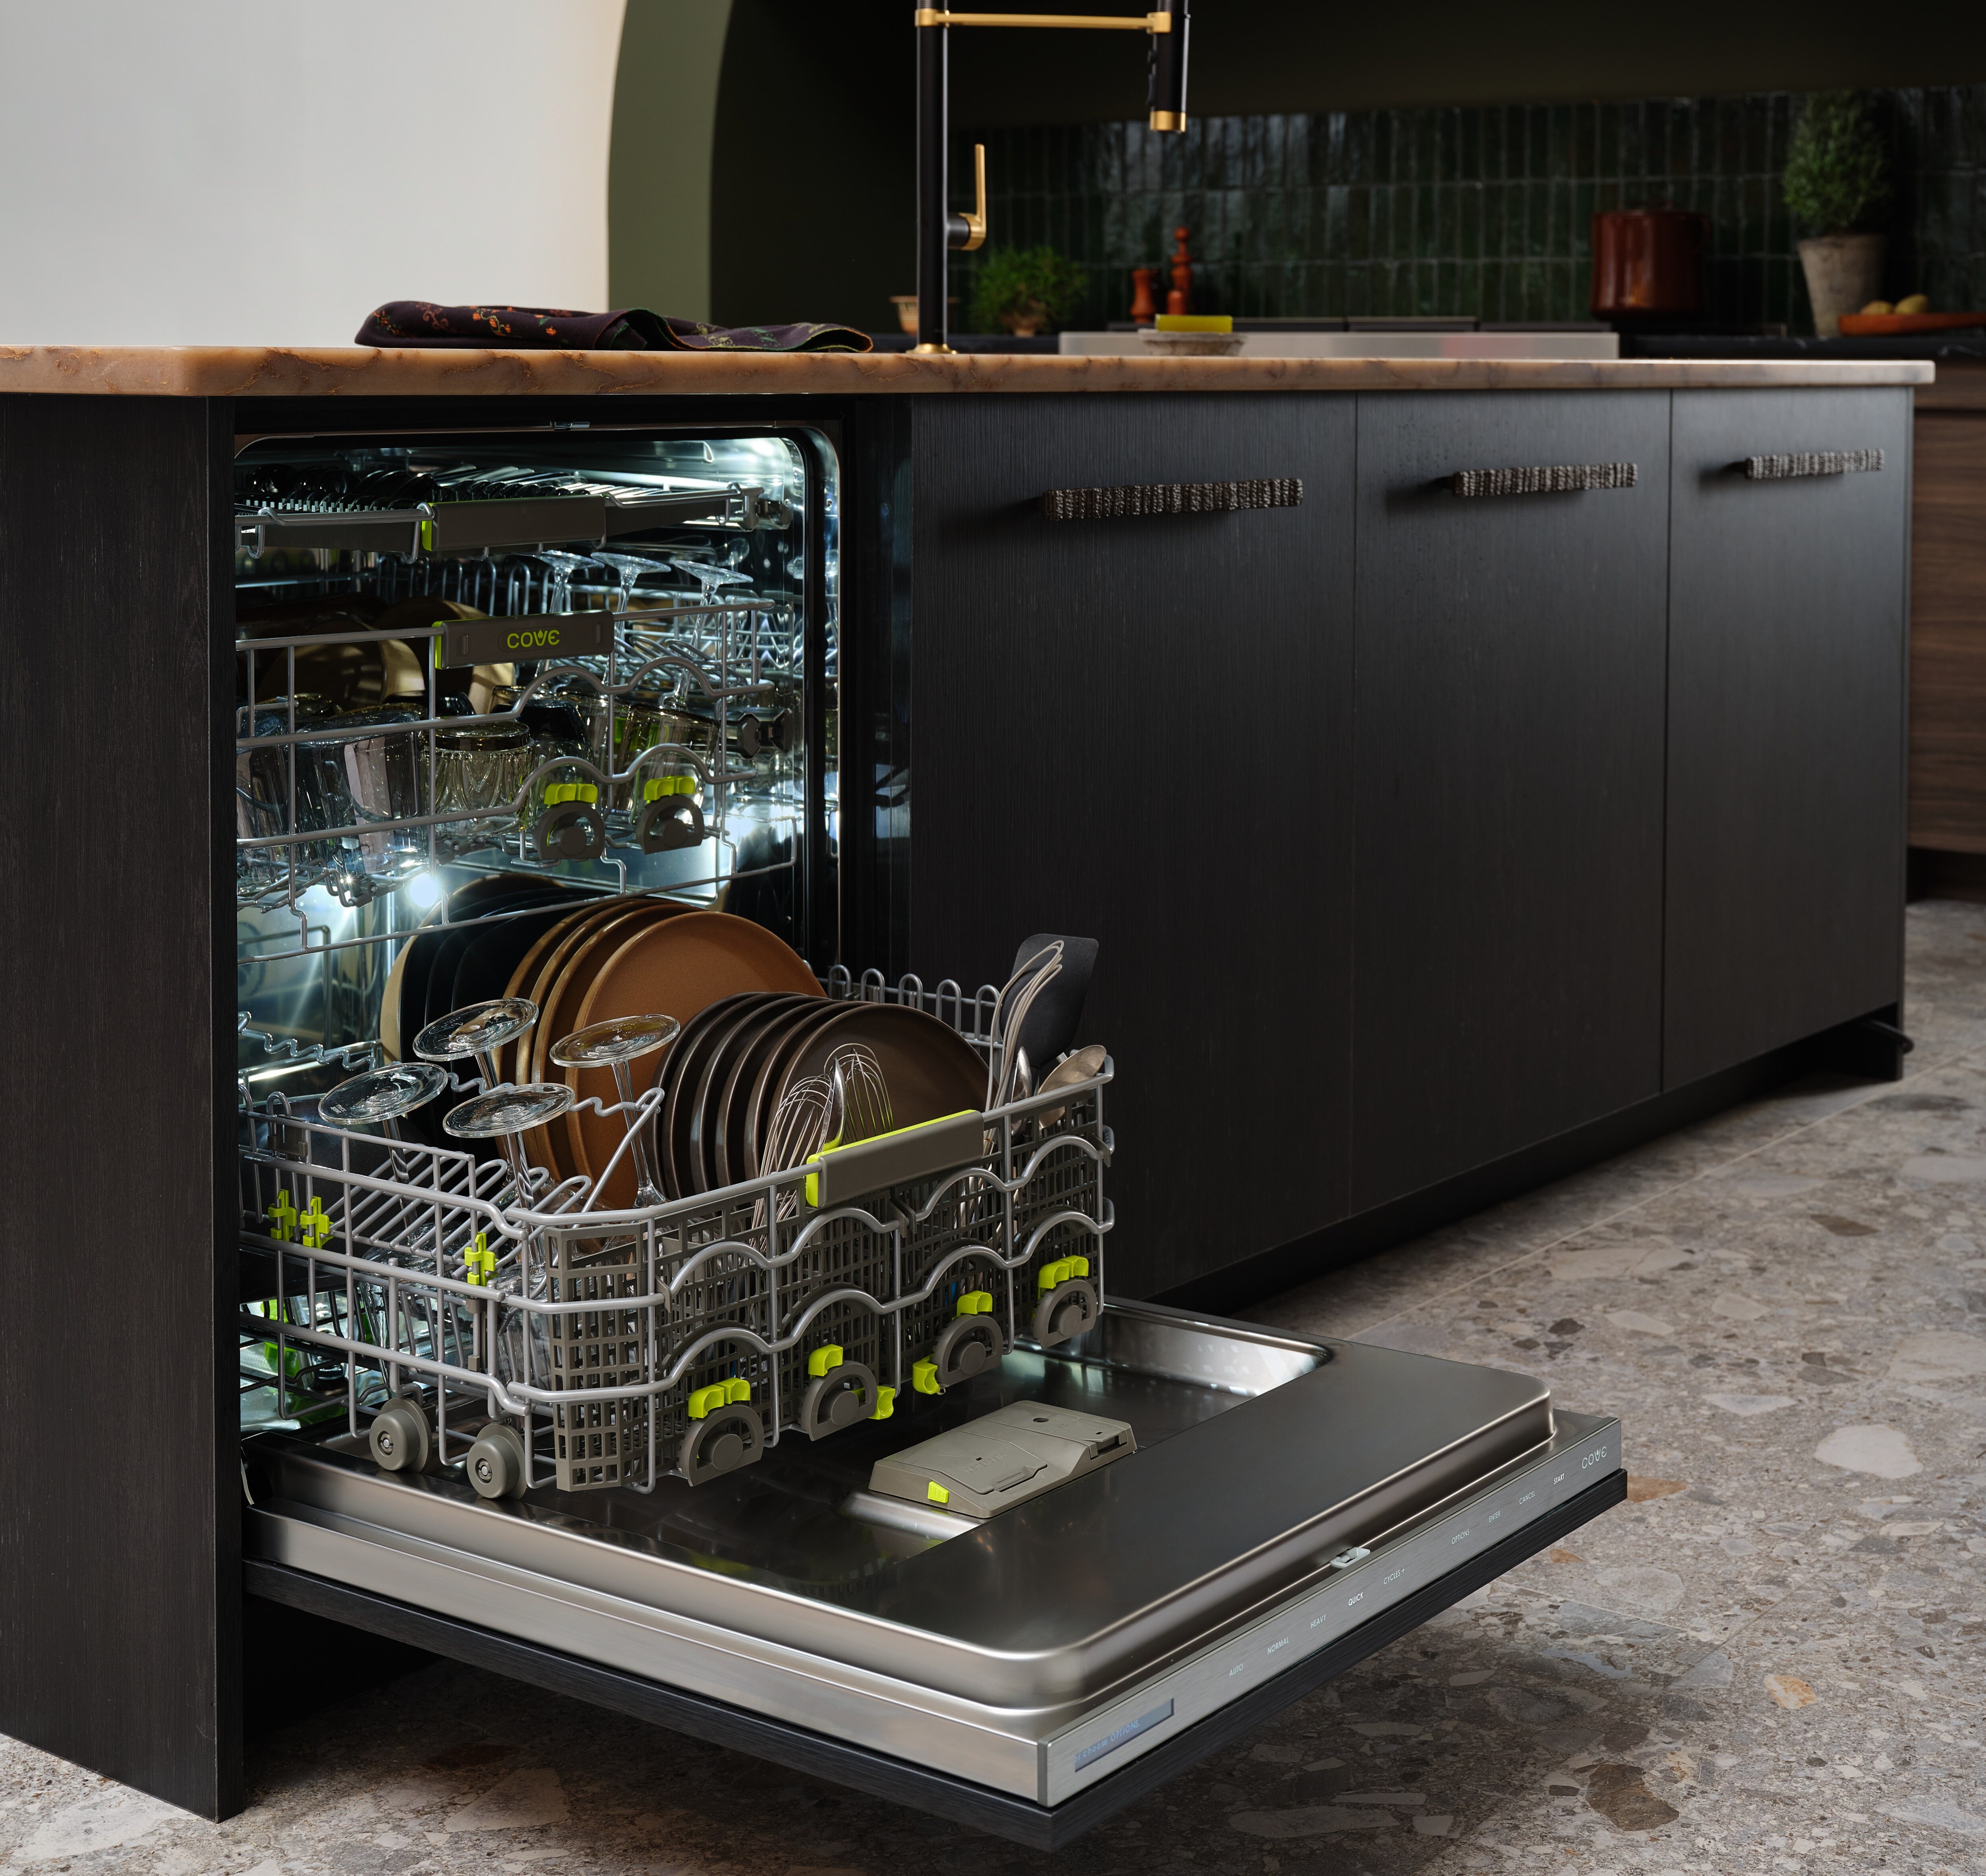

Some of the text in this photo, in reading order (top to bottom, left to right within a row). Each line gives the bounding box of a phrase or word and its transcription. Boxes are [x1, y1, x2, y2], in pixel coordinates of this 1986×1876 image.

[507, 629, 560, 649] COVE
[1582, 1446, 1607, 1469] COVE
[1553, 1473, 1565, 1485] START
[1519, 1490, 1536, 1505] CANCEL
[1489, 1511, 1501, 1522] ENTER
[1451, 1528, 1470, 1544] OPTIONS
[1348, 1592, 1364, 1606] QUICK
[1310, 1613, 1327, 1629] HEAVY
[1267, 1636, 1289, 1654] NORMAL
[1229, 1663, 1244, 1677] AUTO
[1083, 1739, 1108, 1758] choose
[1110, 1719, 1141, 1742] OPTIONS.
